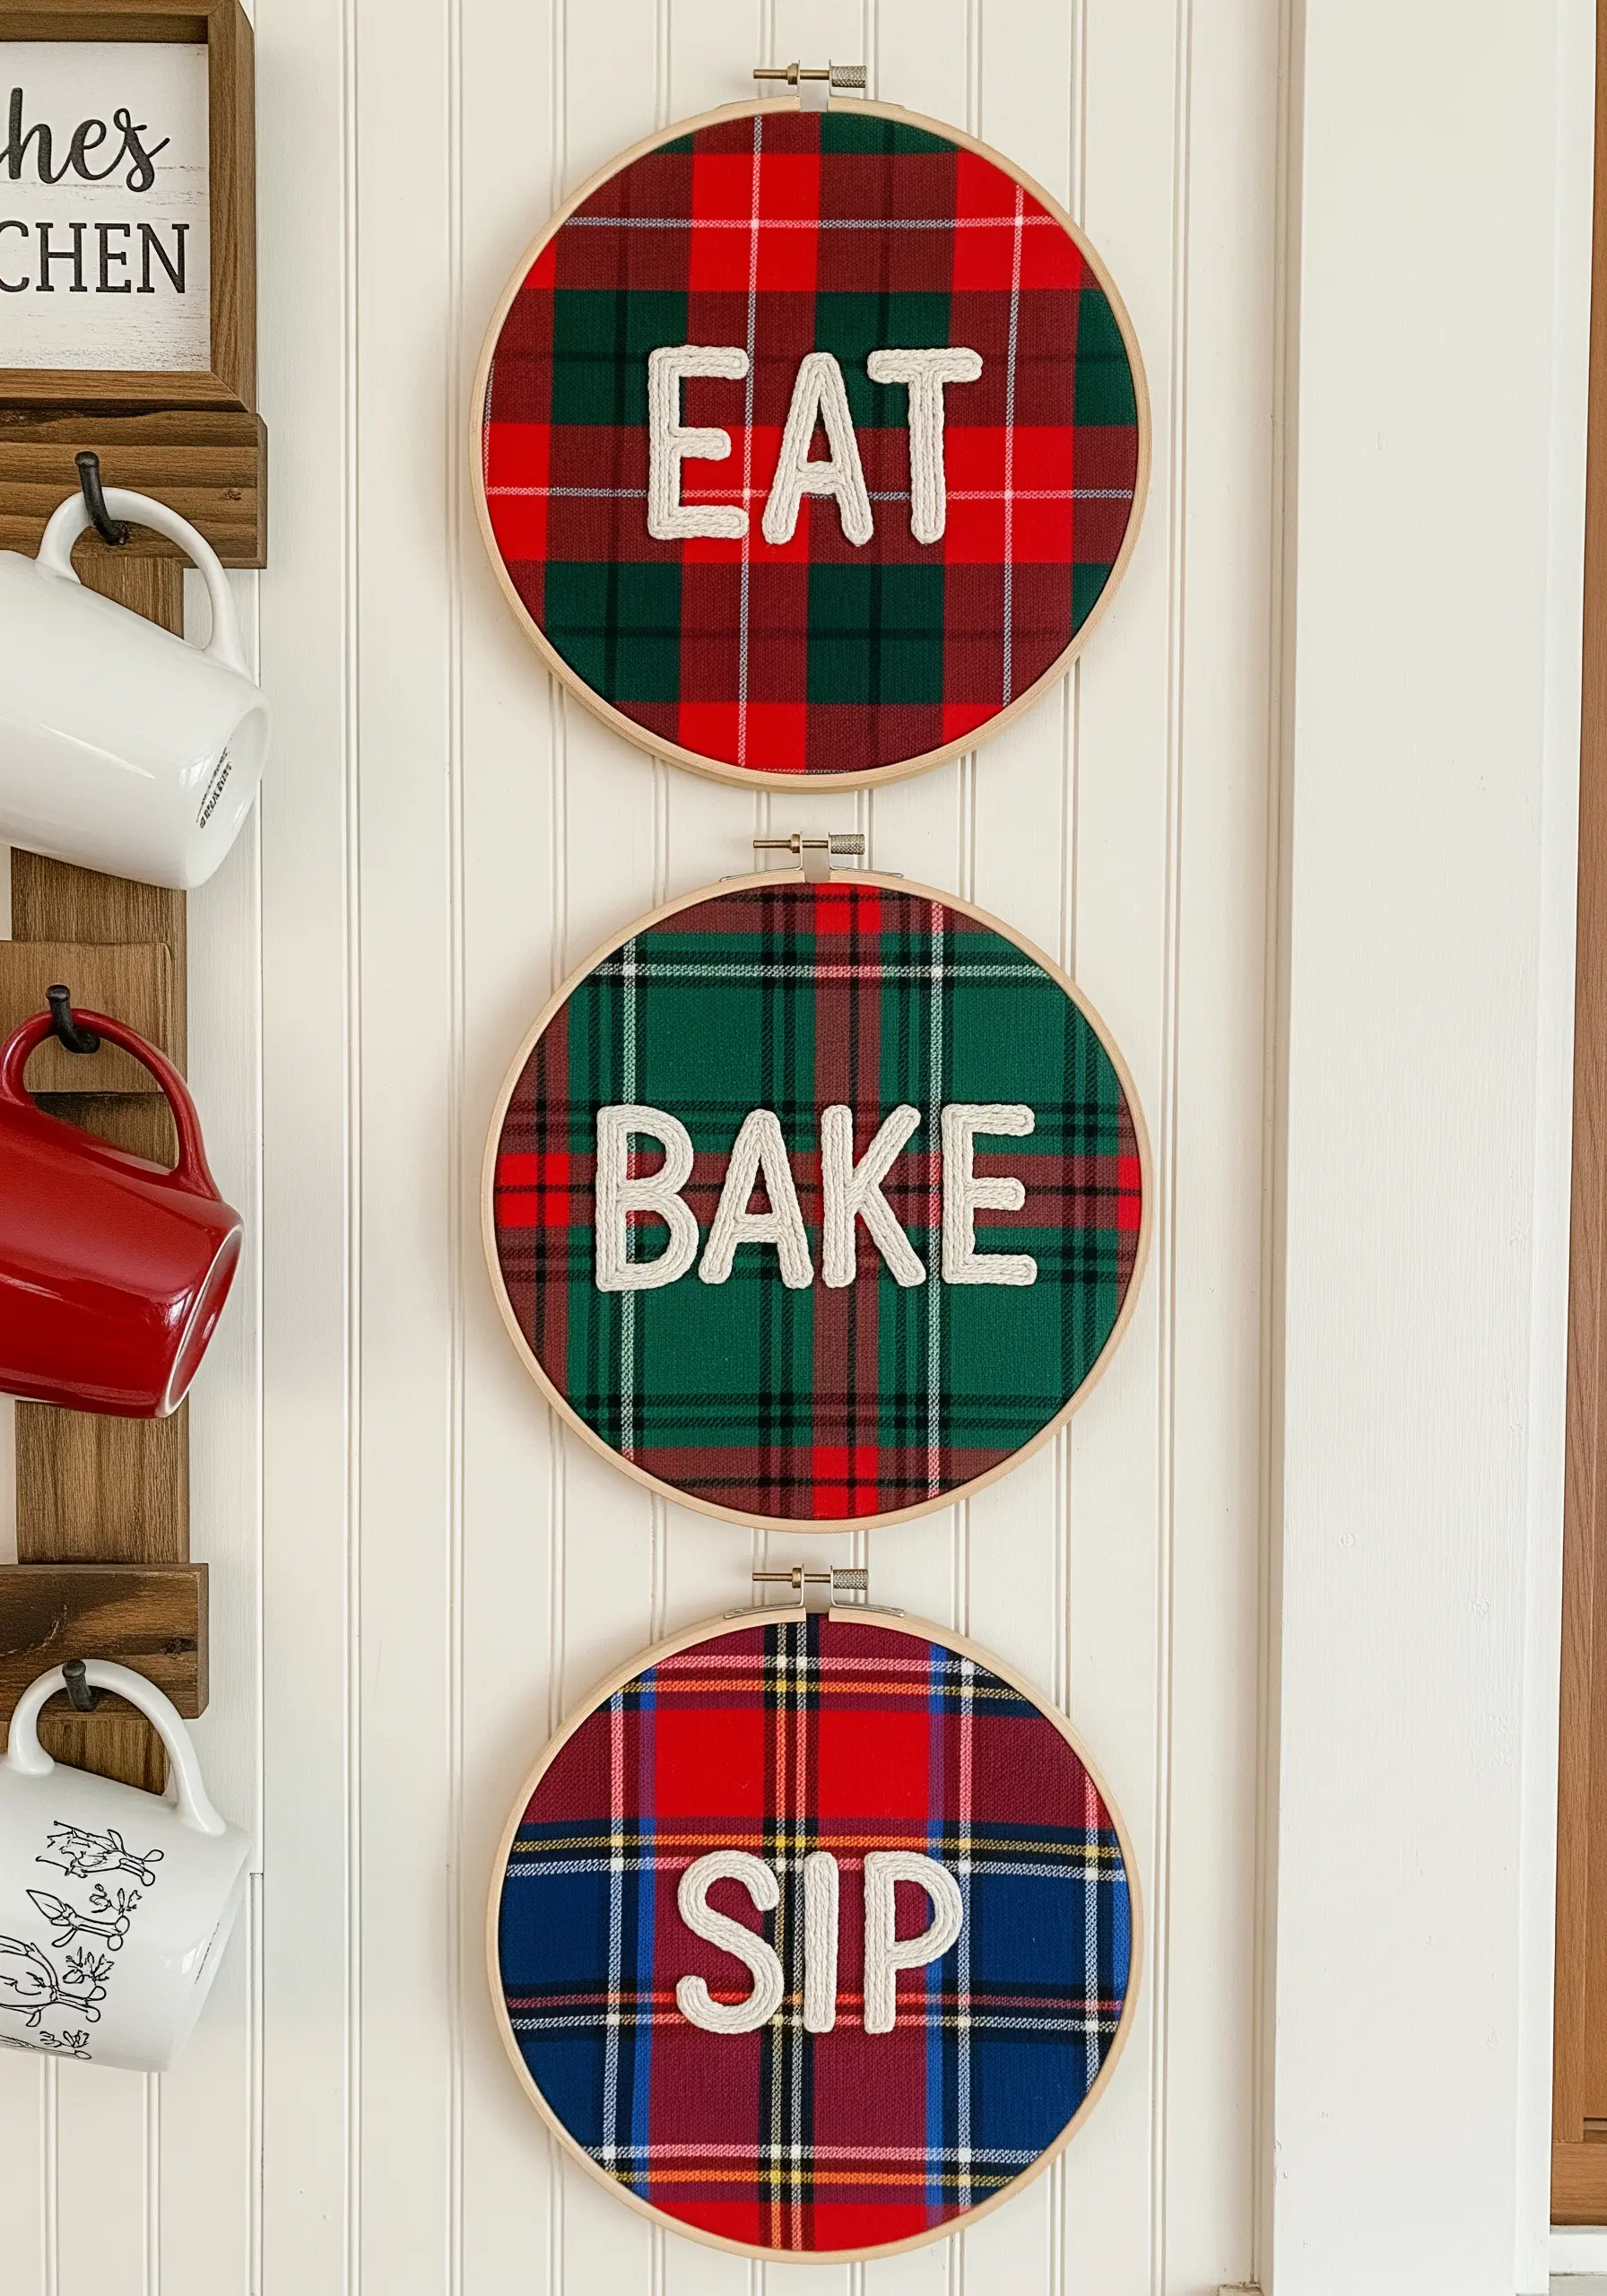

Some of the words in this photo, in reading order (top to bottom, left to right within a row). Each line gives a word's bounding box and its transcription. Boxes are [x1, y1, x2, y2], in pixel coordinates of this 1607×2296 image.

[647, 345, 984, 546] EAT
[595, 1104, 1038, 1292] BAKE
[676, 1849, 964, 2034] SIP
